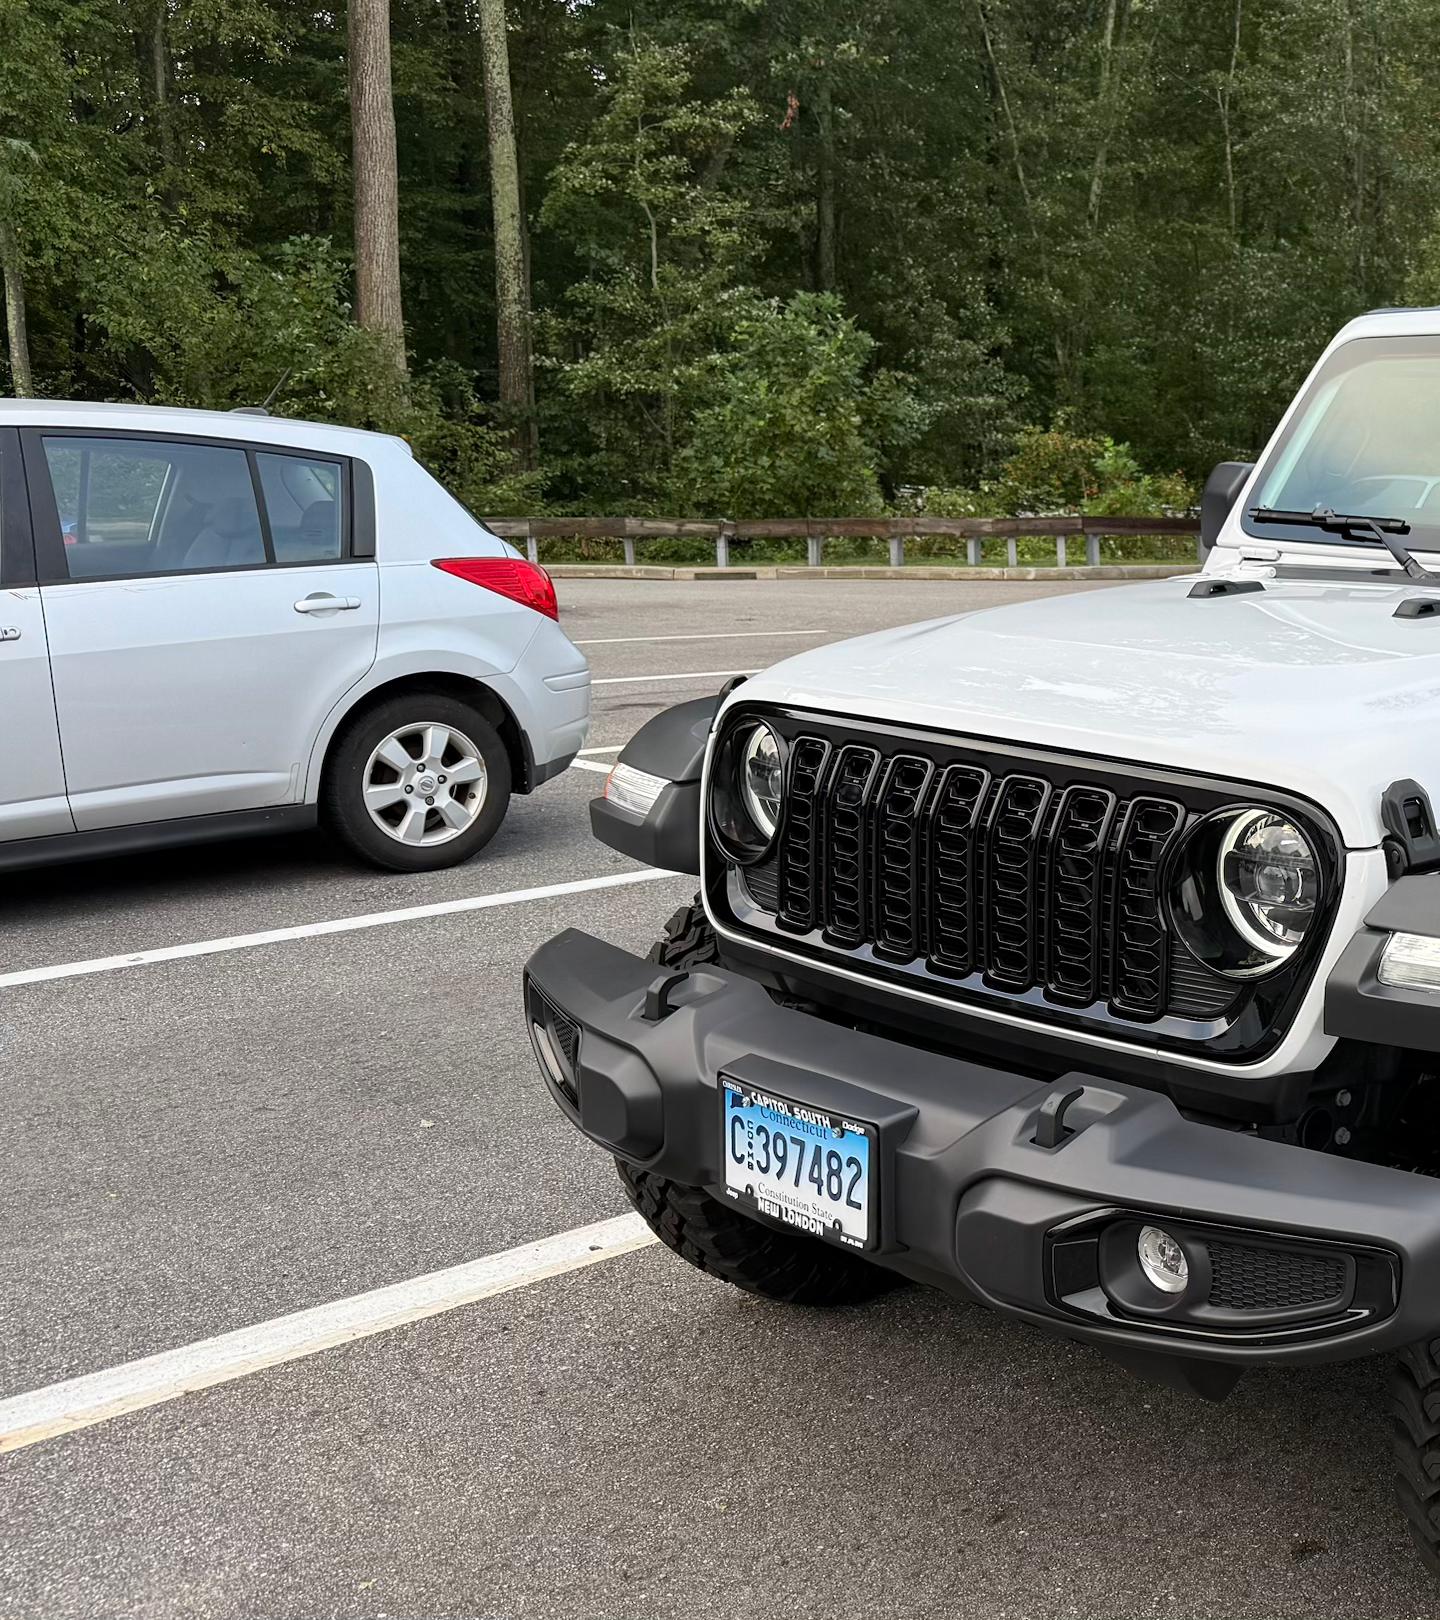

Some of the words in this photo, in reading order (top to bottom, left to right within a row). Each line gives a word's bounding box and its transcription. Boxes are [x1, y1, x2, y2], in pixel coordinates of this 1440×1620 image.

[751, 1091, 792, 1117] CAPITOL
[793, 1106, 831, 1129] SOUTH
[761, 1107, 828, 1140] Connecticut
[842, 1121, 865, 1135] Dodge
[758, 1182, 809, 1212] Constitution
[811, 1202, 833, 1221] State
[758, 1197, 780, 1218] NEW
[781, 1206, 824, 1236] LONDON
